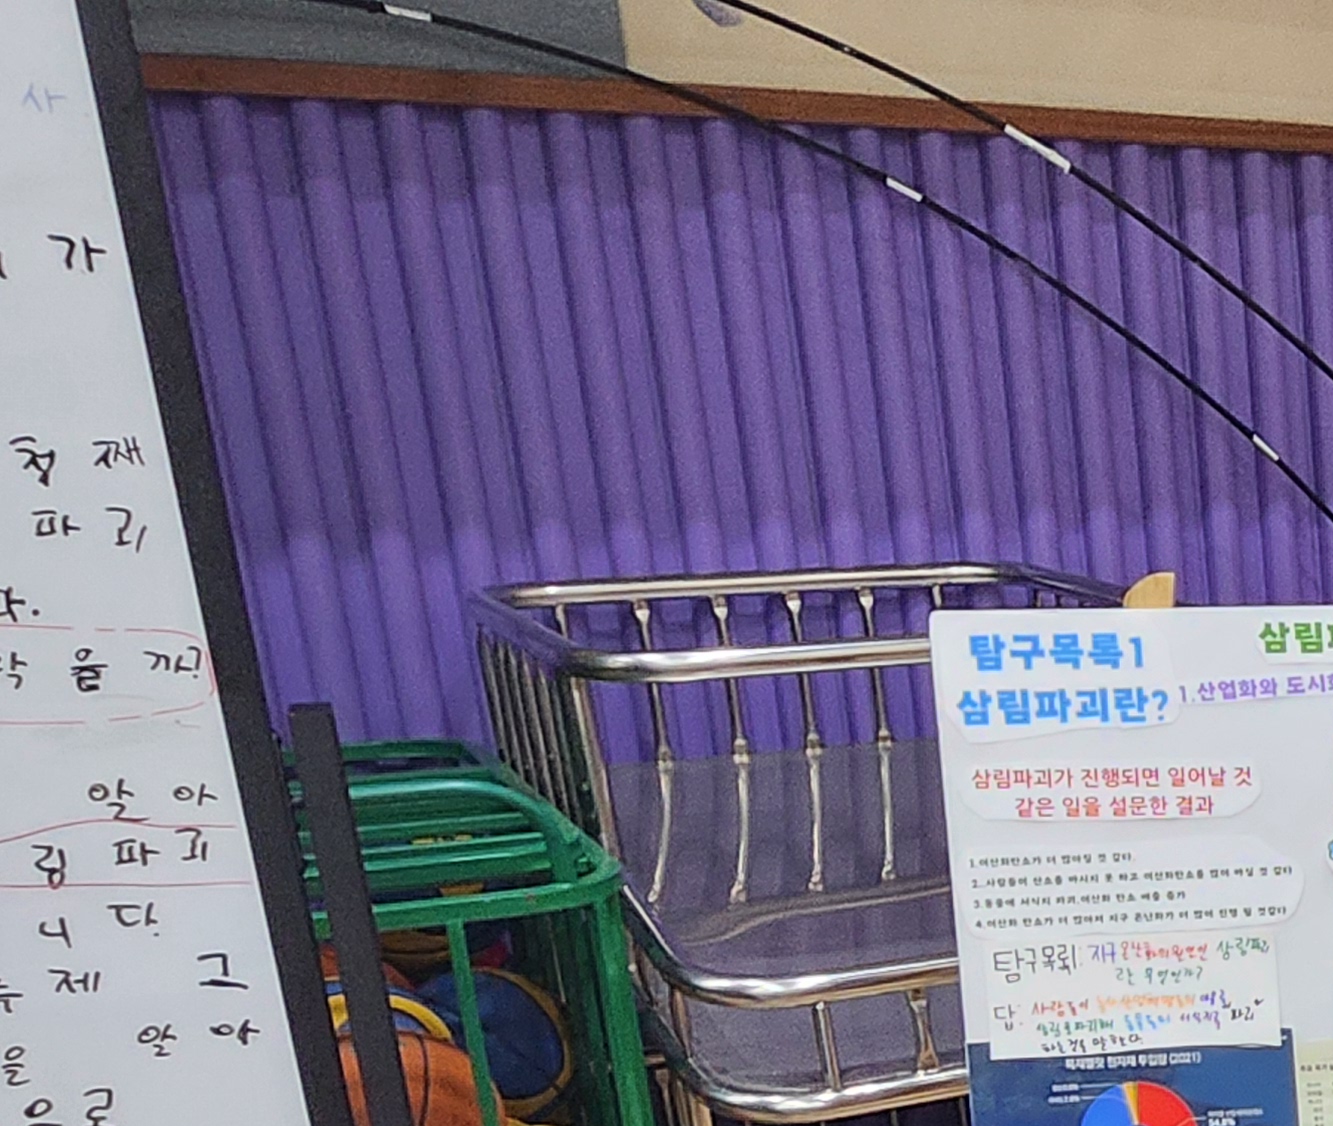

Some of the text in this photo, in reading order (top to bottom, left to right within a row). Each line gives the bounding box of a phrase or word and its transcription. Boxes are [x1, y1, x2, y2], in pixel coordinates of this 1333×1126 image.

[968, 631, 1144, 672] 탐구목록1
[1080, 767, 1160, 788] 진행되면
[1167, 766, 1226, 787] 일어날
[1233, 766, 1253, 786] 것
[1015, 795, 1214, 818] 같은 일을 설문한 결과
